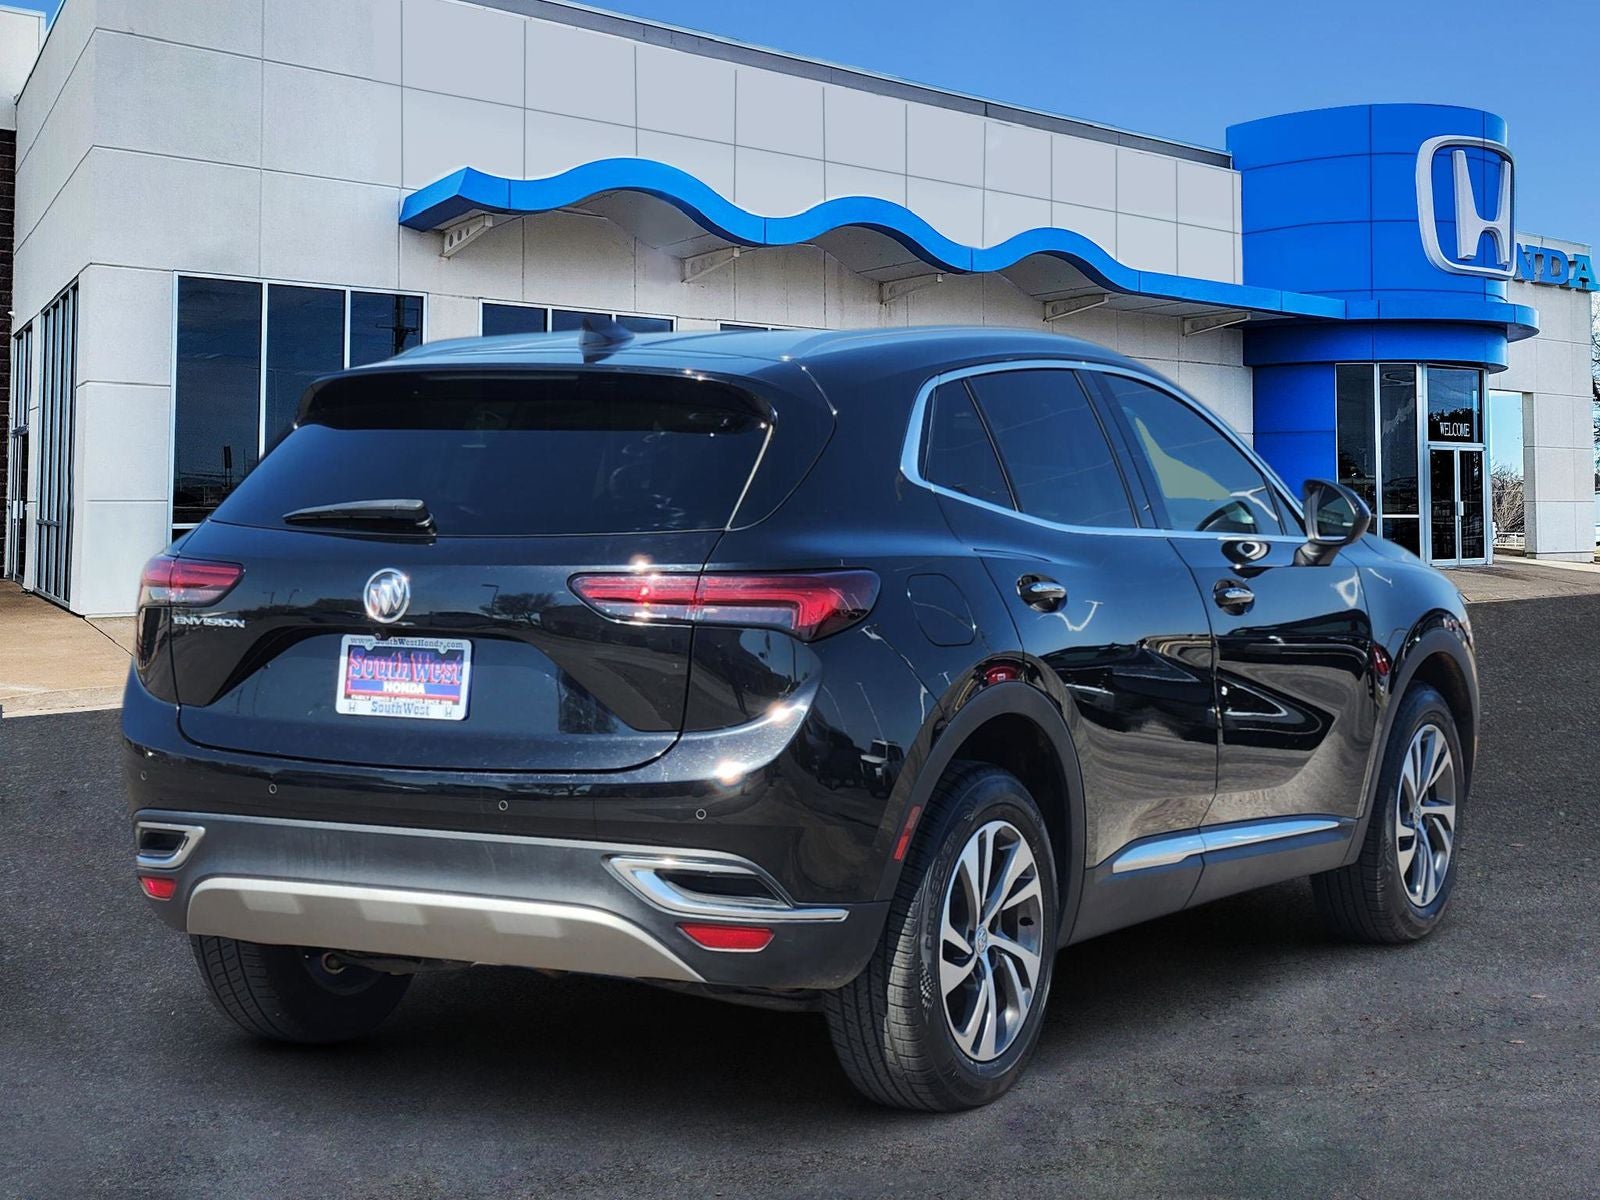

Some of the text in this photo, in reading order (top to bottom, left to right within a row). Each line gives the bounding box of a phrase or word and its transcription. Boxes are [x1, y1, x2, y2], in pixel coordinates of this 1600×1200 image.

[1514, 243, 1600, 292] NDA
[1440, 422, 1470, 437] WELCOME
[173, 616, 245, 628] ENVISION
[383, 680, 426, 695] HONDA
[371, 700, 431, 717] SouthWest
